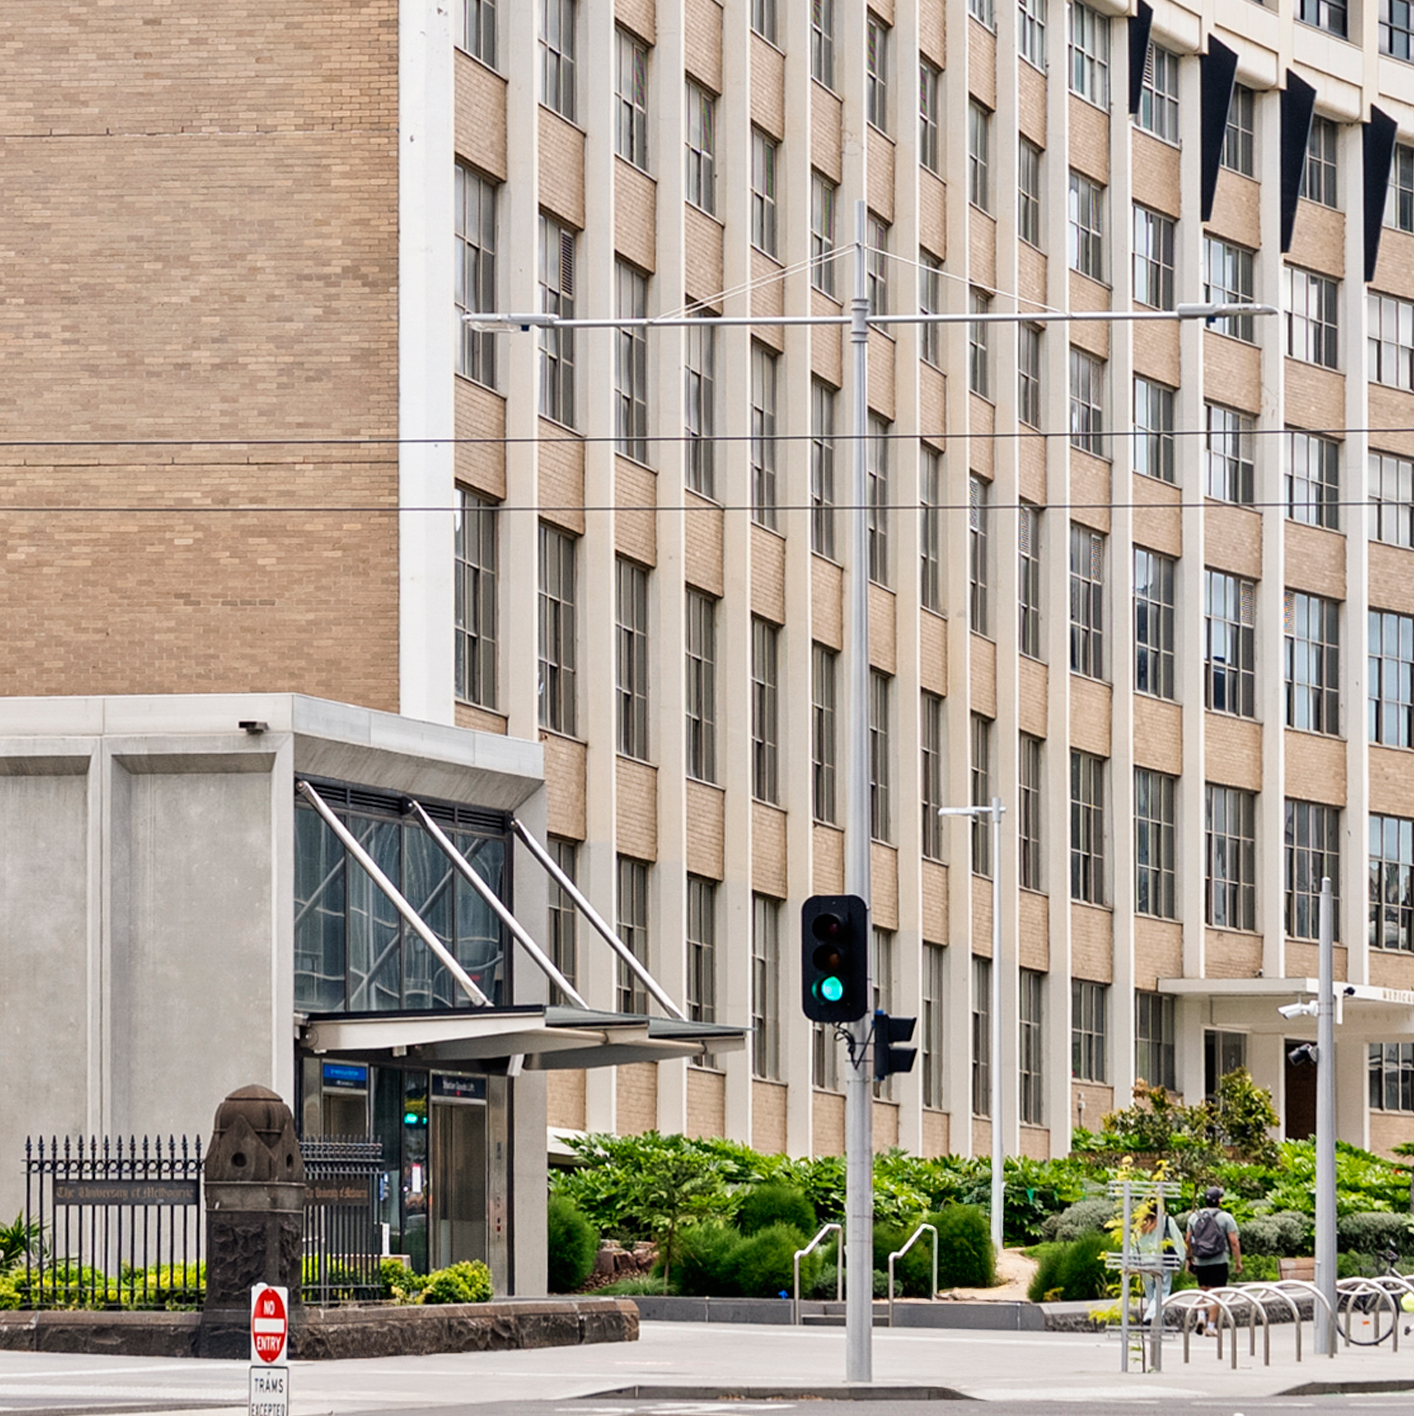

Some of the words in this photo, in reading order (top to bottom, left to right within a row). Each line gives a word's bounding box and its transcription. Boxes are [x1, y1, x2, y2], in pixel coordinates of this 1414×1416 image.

[55, 1186, 75, 1199] The
[78, 1186, 128, 1200] University
[263, 1300, 276, 1315] NO
[256, 1335, 282, 1351] ENTRY
[254, 1378, 284, 1394] TRAMS
[251, 1403, 286, 1416] EXCEPTED
